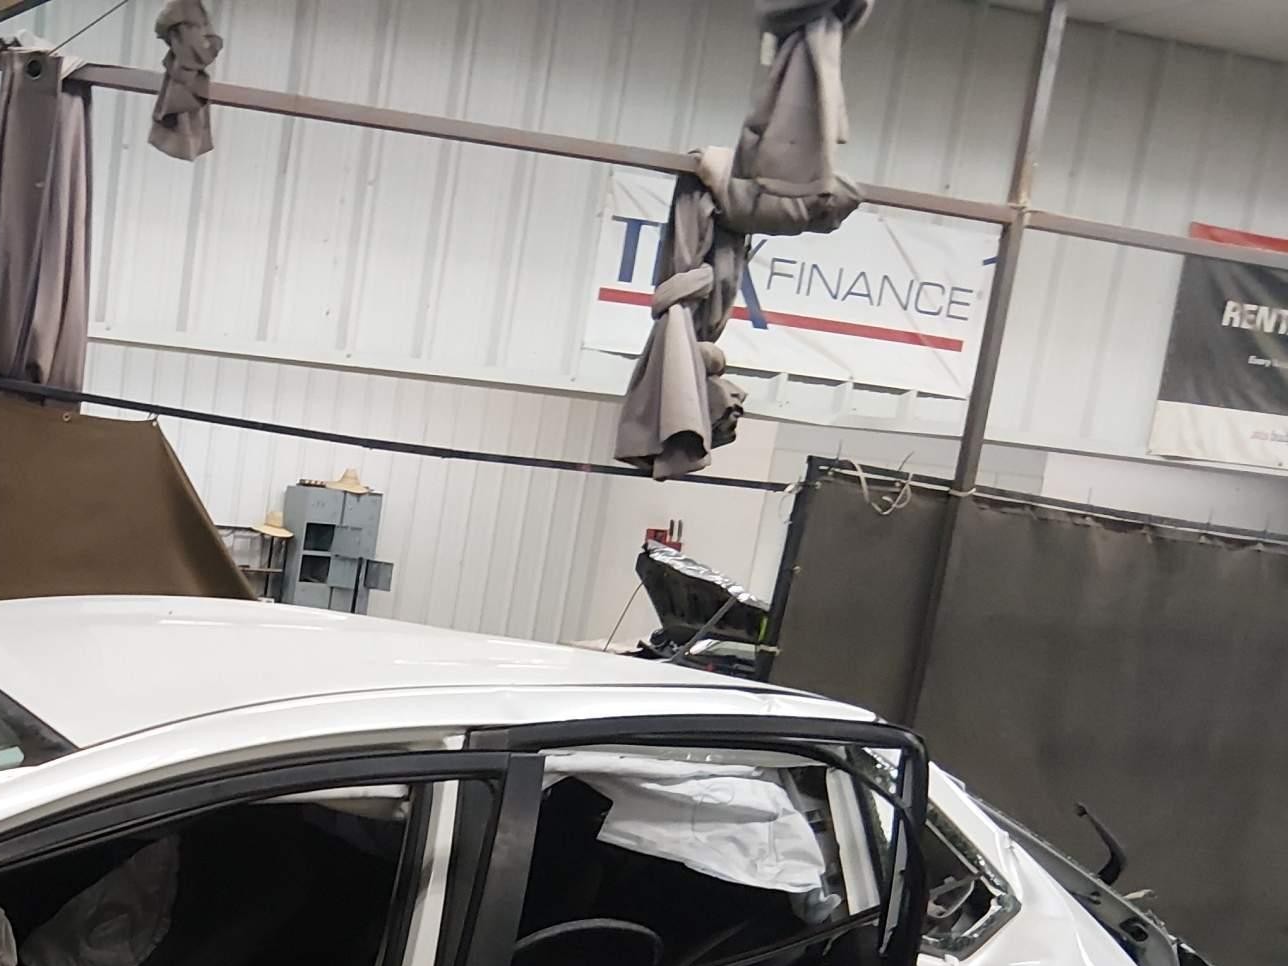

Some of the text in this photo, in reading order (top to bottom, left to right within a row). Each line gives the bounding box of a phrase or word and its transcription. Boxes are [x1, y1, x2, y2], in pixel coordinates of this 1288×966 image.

[612, 215, 974, 331] TX FINANCE
[1221, 300, 1288, 334] RENT
